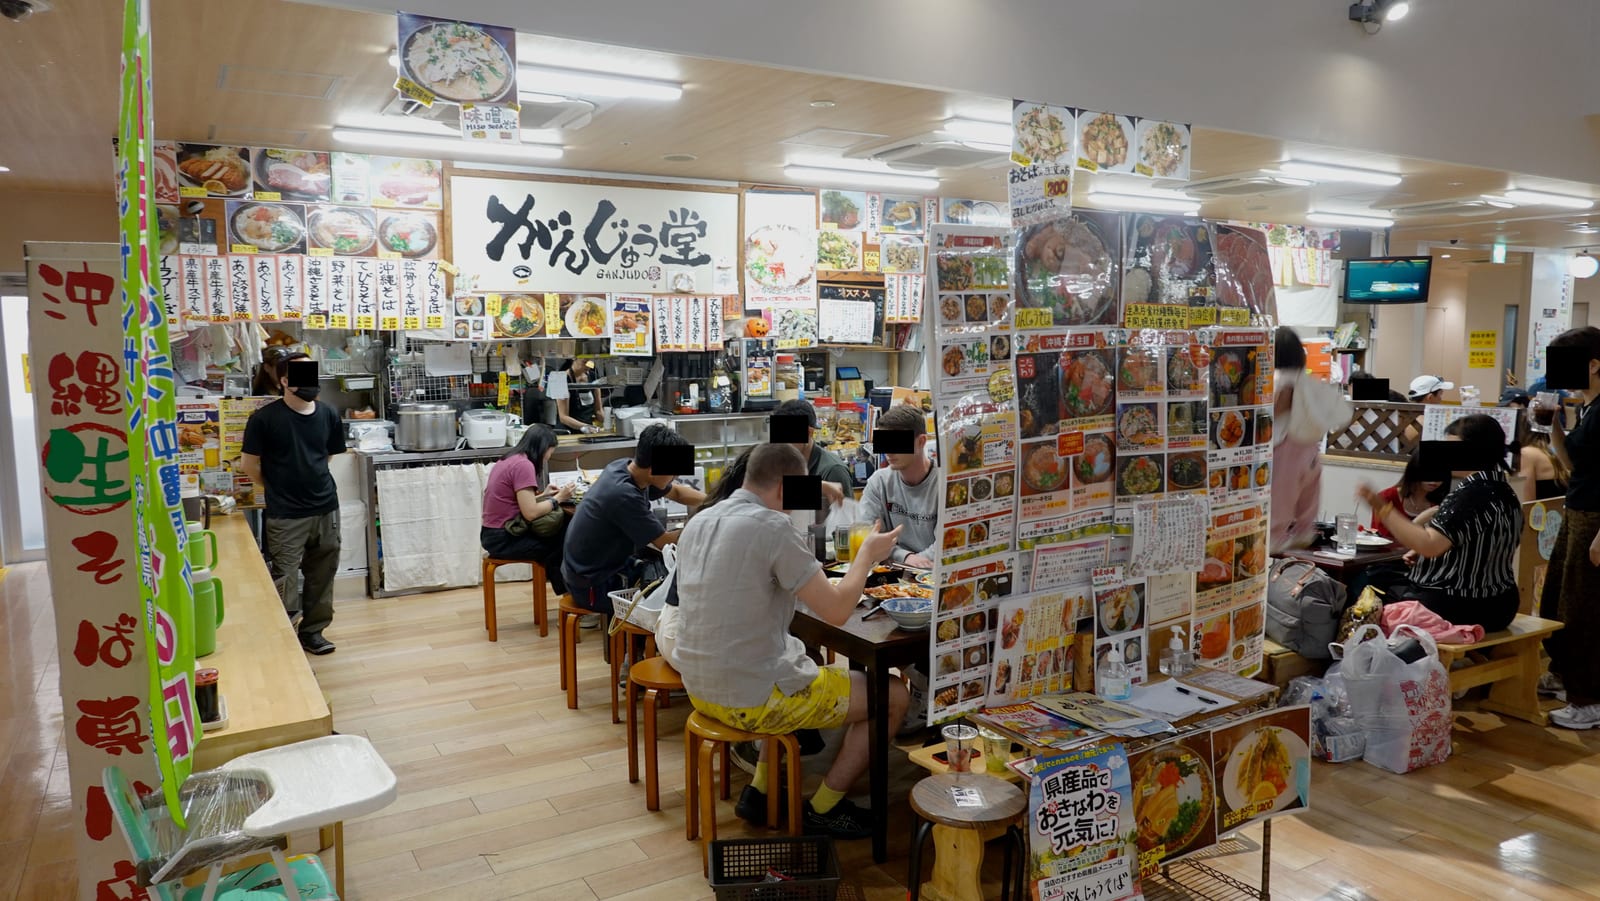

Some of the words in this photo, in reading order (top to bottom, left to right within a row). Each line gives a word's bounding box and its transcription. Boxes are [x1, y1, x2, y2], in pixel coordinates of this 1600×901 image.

[486, 193, 711, 275] がんじゅう堂
[380, 261, 398, 311] 沖縄そば
[597, 271, 648, 280] GANJUDO
[838, 286, 871, 299] オススメ
[1044, 769, 1109, 800] 県産品で
[1038, 790, 1118, 830] おきなわを
[1053, 818, 1116, 851] 元気に!
